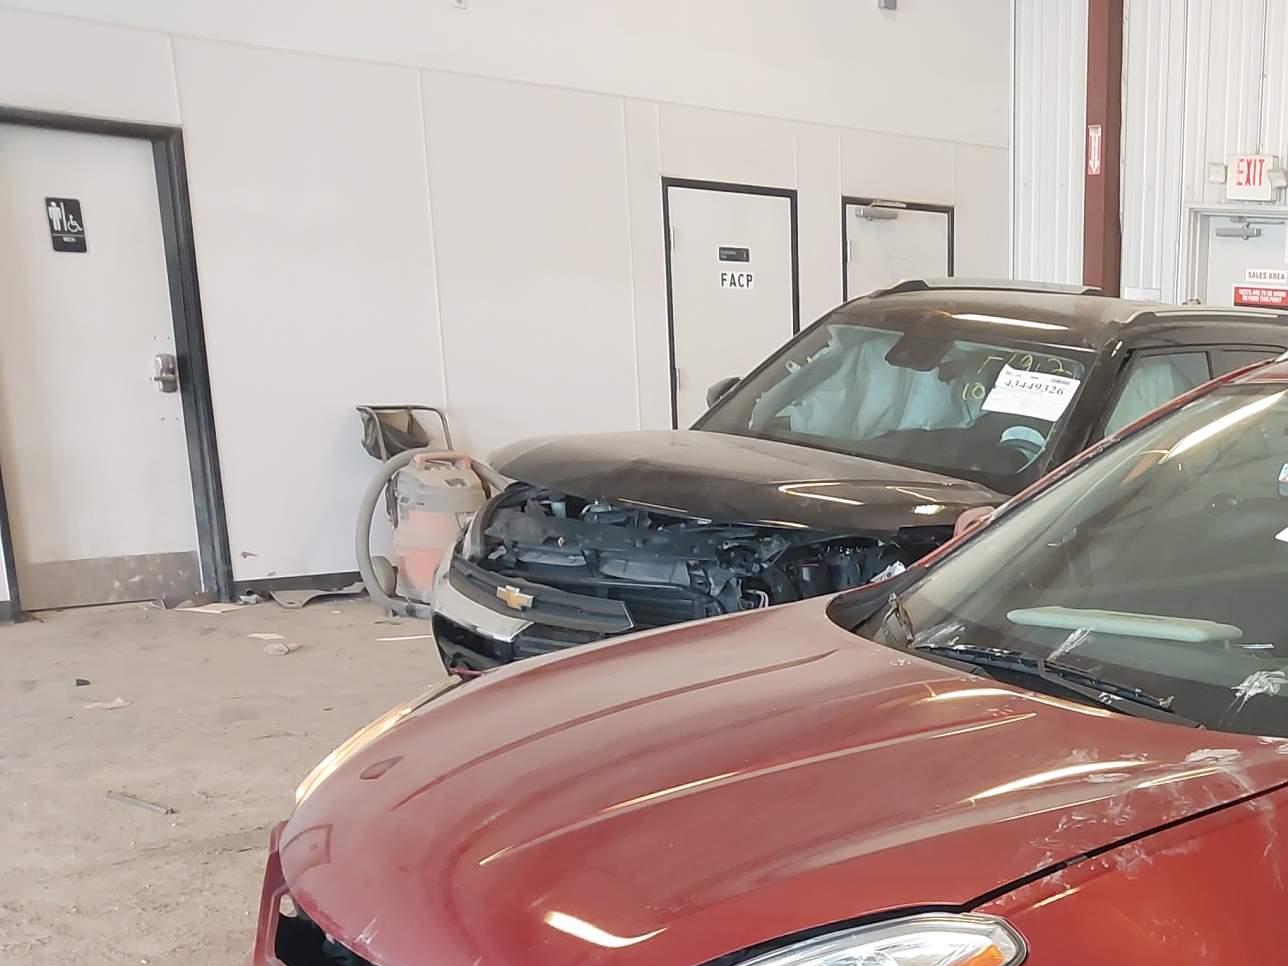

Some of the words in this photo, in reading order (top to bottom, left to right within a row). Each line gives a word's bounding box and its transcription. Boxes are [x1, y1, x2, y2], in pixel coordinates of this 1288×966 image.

[1235, 157, 1265, 187] EXIT
[721, 271, 753, 289] FACP
[1247, 271, 1268, 280] SALES
[1004, 379, 1064, 396] 43449326
